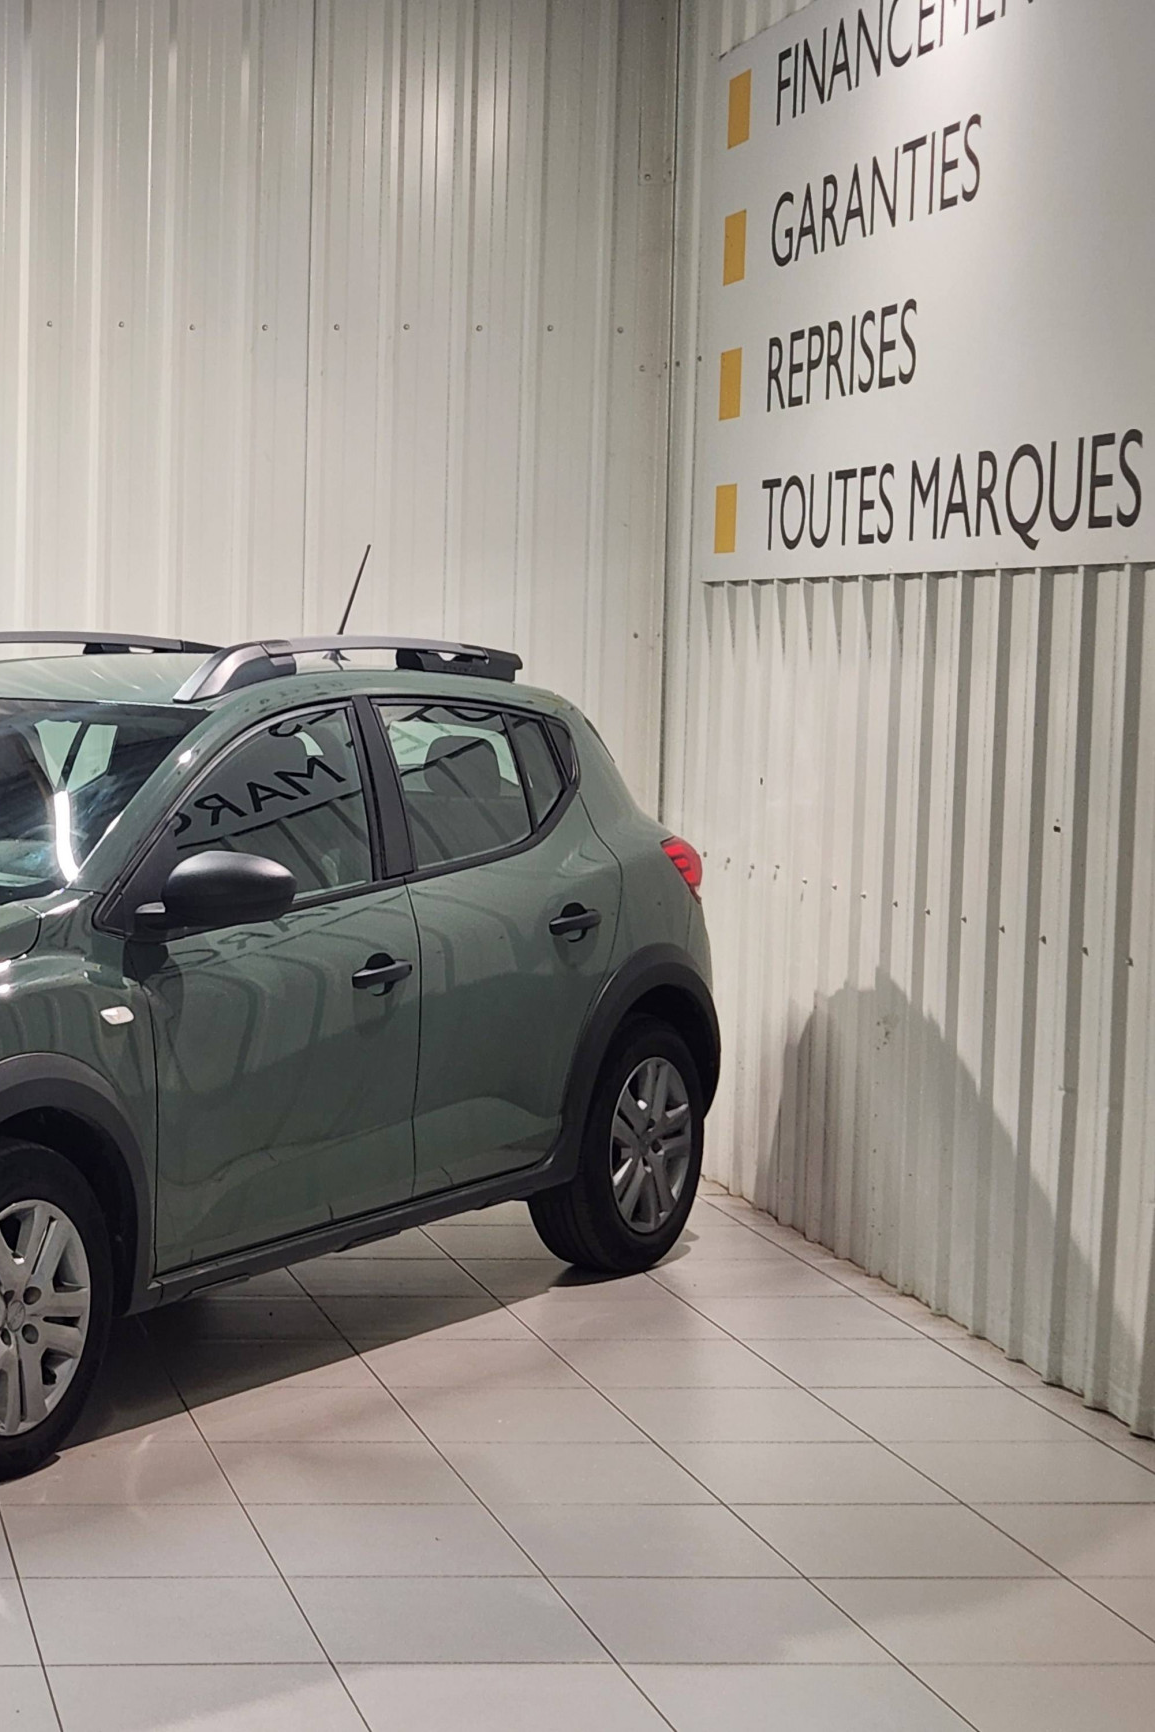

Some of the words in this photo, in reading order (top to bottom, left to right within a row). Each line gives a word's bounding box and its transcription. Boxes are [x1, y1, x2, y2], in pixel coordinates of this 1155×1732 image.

[776, 0, 1034, 126] FINANCE
[771, 113, 982, 267] GARANTIES
[767, 299, 917, 412] REPRISES
[762, 463, 894, 551] TOUTES
[908, 429, 1143, 551] MARQUES
